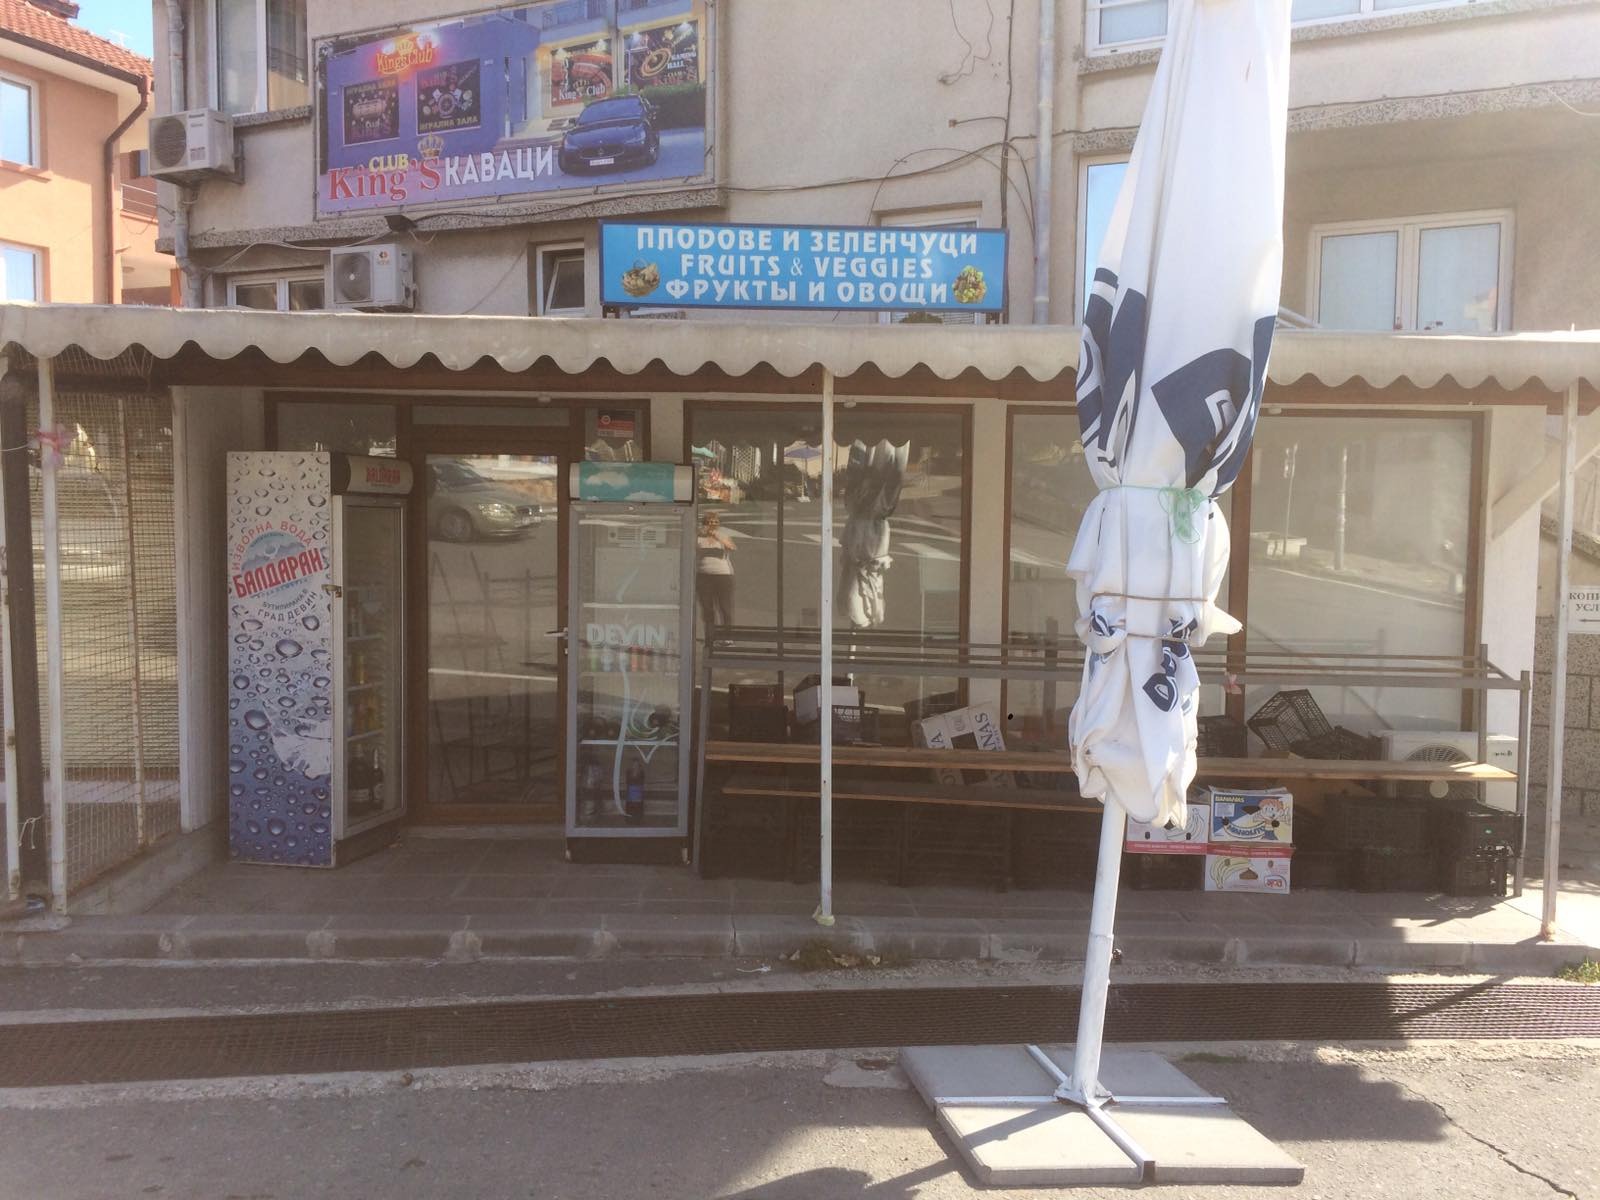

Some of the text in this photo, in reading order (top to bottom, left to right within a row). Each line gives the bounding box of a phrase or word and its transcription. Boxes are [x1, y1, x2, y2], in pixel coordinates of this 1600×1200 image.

[369, 153, 409, 173] CLUB
[445, 145, 553, 186] КАВАЦИ
[783, 230, 800, 251] И
[810, 231, 977, 258] ЗЕЛЕНЧУЦИ
[681, 254, 933, 279] FRUITS & VEGGIES
[666, 279, 947, 305] ФРУКТЫ И ОВОЩИ
[232, 521, 273, 571] ИЗВОРНА
[280, 521, 313, 547] ВОДА
[232, 547, 324, 598] БАЛДАРАН
[258, 591, 317, 622] ГРАД ДЕВИН
[587, 624, 665, 648] DEVIN
